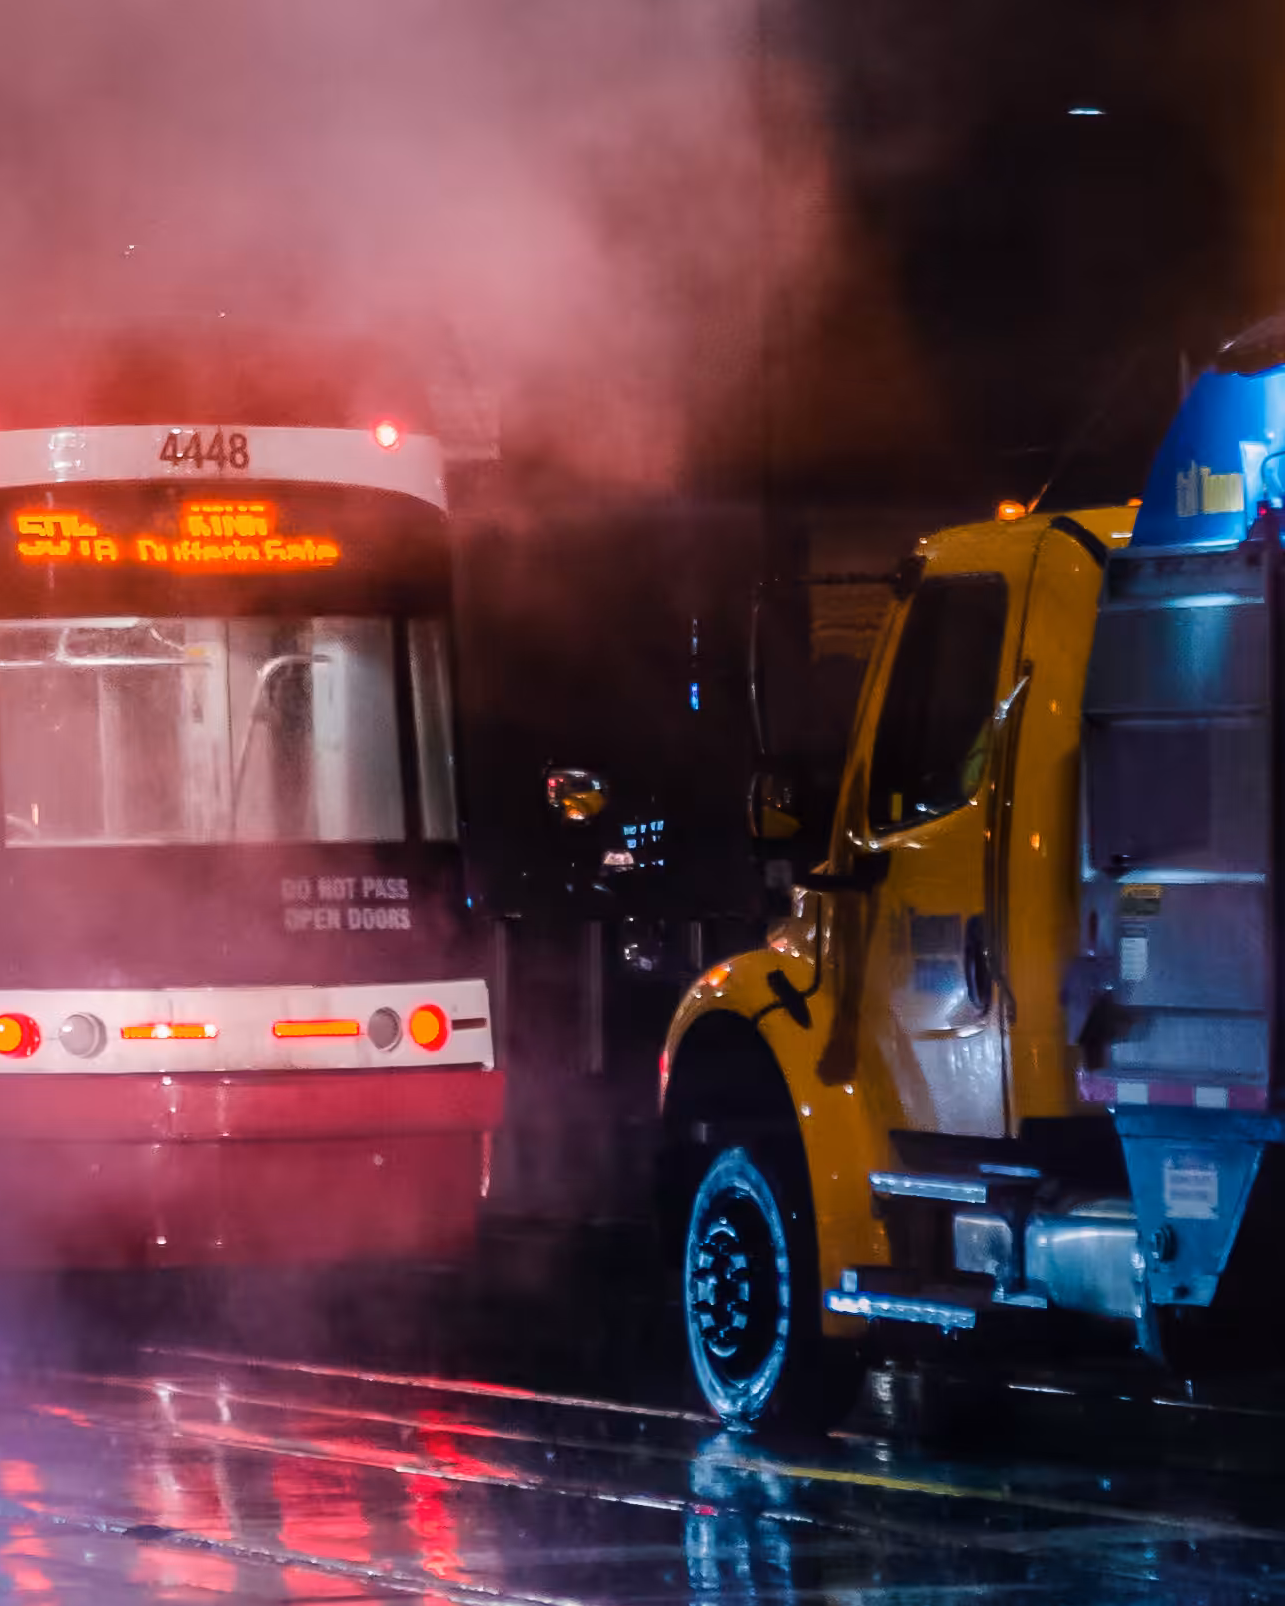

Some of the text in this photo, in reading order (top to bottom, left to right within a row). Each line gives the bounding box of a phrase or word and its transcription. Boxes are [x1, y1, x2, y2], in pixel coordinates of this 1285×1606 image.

[159, 432, 250, 469] 4448
[281, 877, 409, 900] DO NOT PASS
[284, 907, 412, 931] OPEN DOORS
